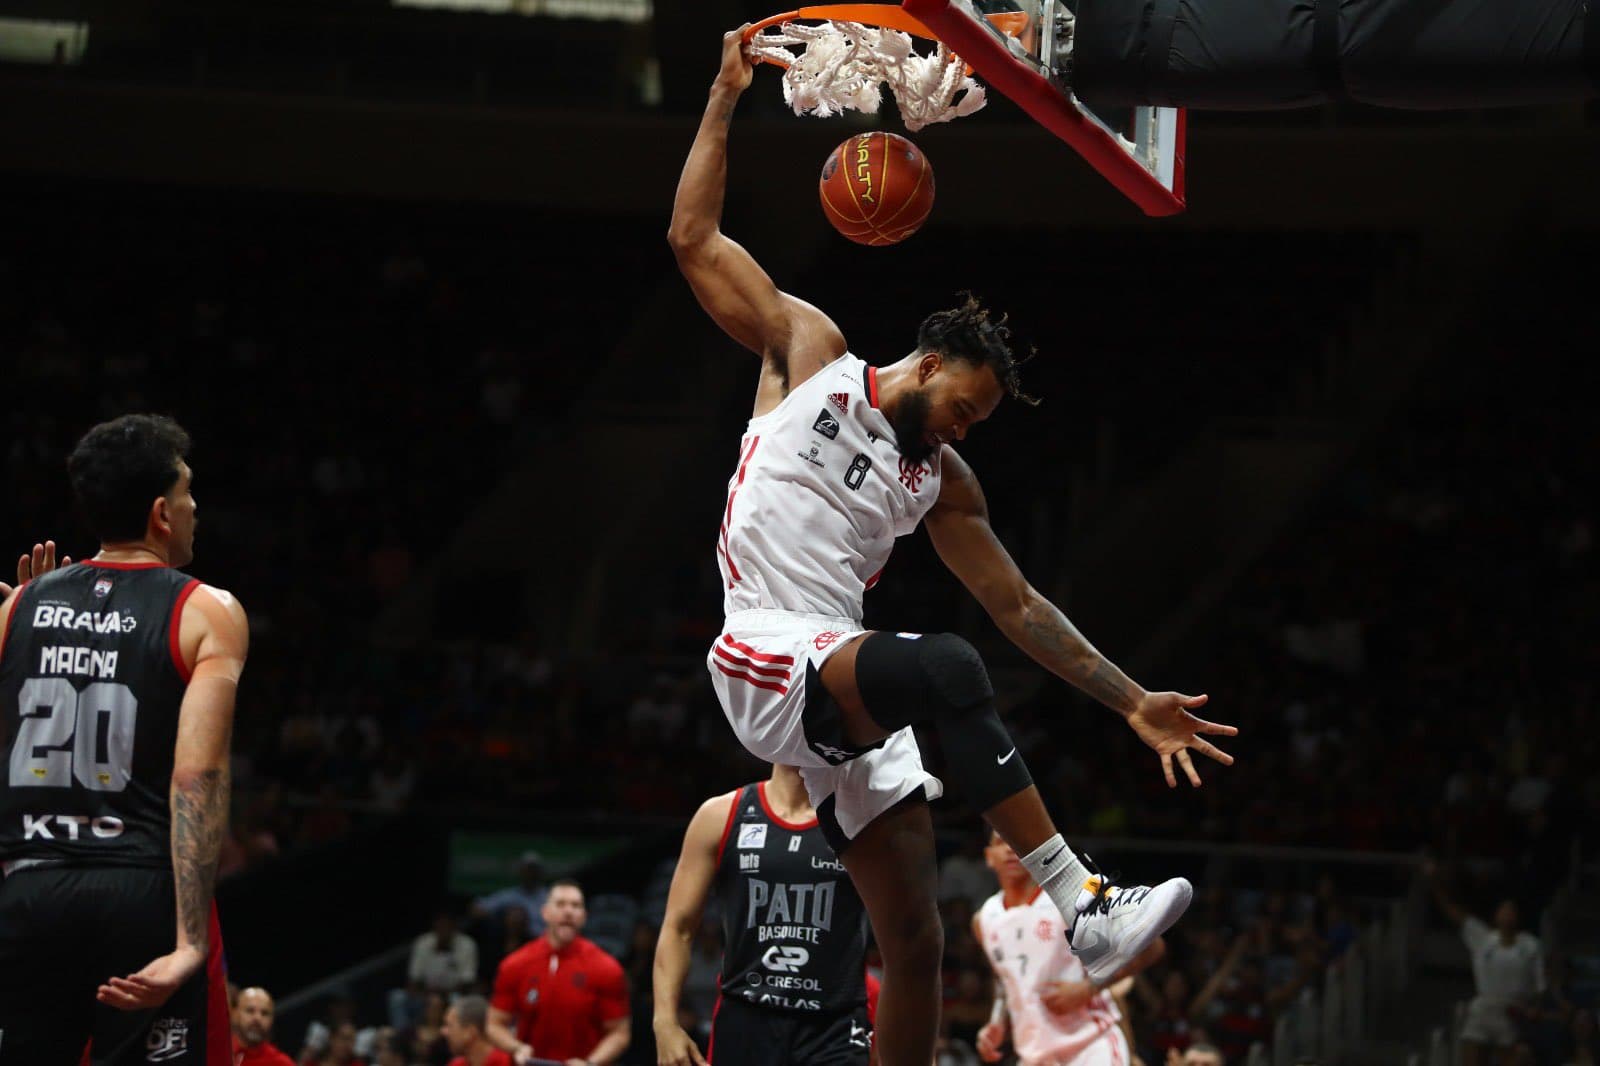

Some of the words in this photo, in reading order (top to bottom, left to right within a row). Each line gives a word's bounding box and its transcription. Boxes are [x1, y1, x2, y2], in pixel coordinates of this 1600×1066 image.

[844, 453, 872, 491] 8
[40, 646, 118, 678] MAGNA
[9, 677, 138, 792] 20
[23, 814, 124, 840] KTO
[747, 877, 837, 932] PATO
[758, 926, 820, 945] BASQUETE
[766, 975, 822, 992] CRESOL
[759, 993, 821, 1010] ATLAS
